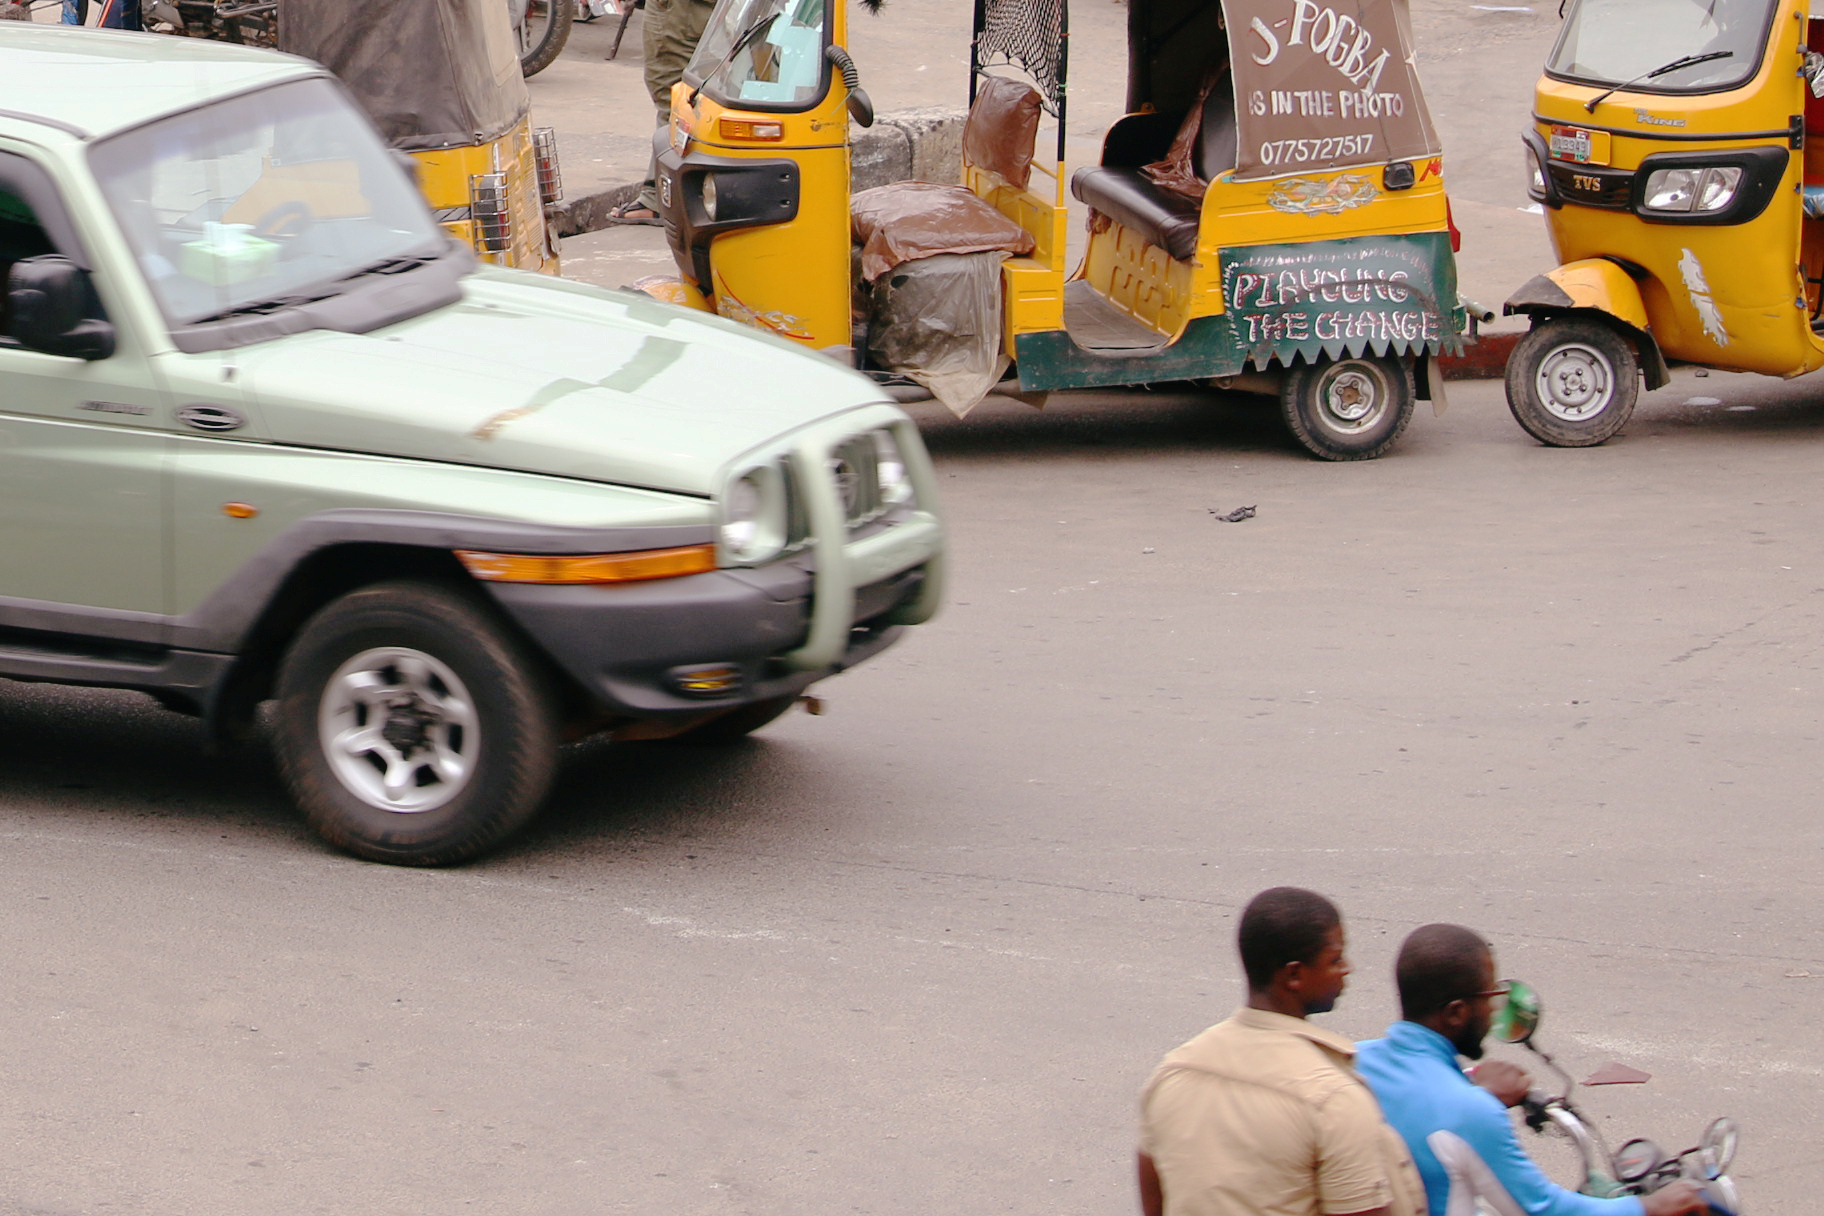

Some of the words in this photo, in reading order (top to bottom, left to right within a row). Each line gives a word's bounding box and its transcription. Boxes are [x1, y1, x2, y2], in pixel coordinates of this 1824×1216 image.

[1249, 90, 1266, 116] IS
[1271, 90, 1293, 116] IN
[1294, 90, 1335, 117] THE
[1340, 90, 1404, 119] PHOTO
[1260, 134, 1375, 166] 0775727517
[1573, 175, 1602, 192] TVS
[1243, 310, 1309, 343] THE
[1315, 309, 1440, 343] CHANGE
